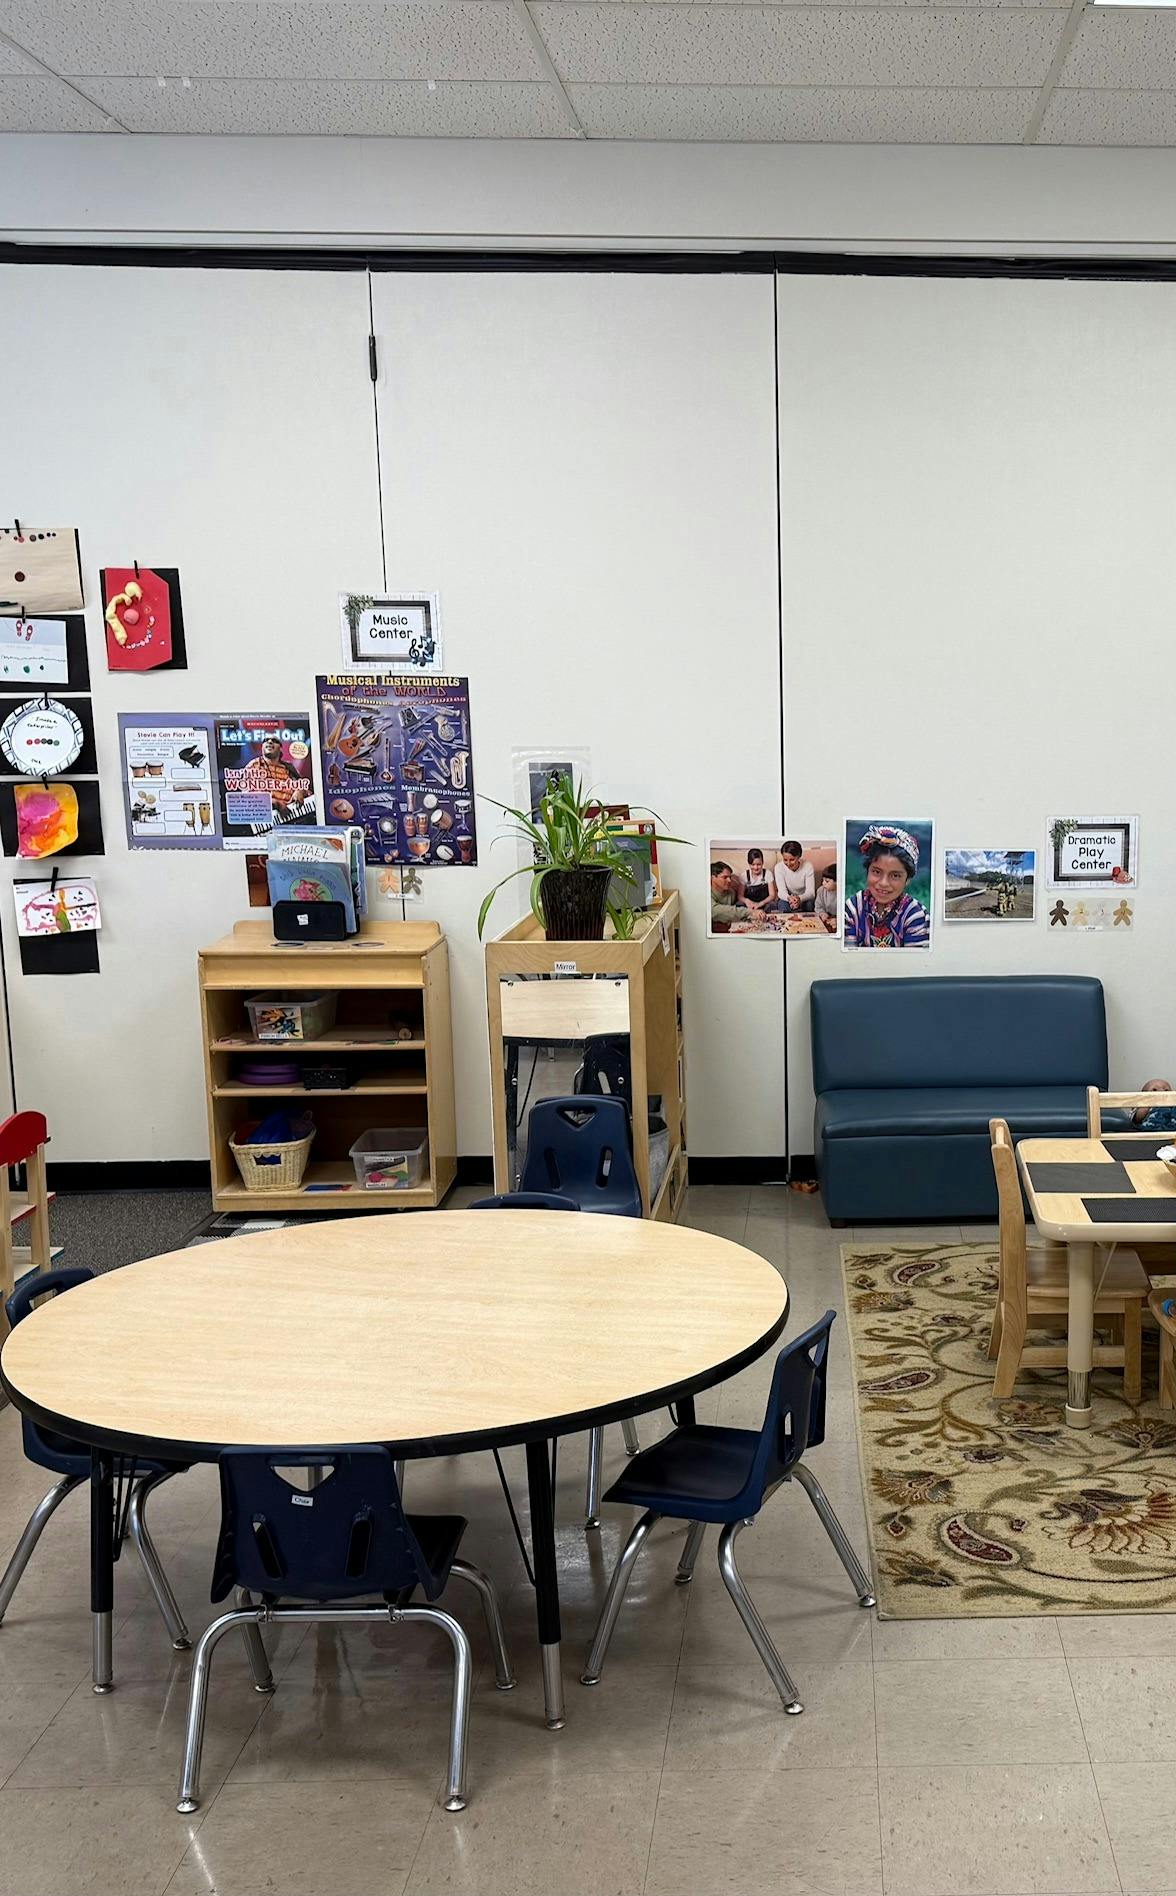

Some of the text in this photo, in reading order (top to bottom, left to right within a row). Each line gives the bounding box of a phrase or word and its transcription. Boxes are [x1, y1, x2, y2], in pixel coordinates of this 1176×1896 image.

[373, 614, 408, 626] Music
[369, 627, 413, 639] Center
[326, 675, 460, 687] Musical Instruments
[342, 686, 356, 696] of
[362, 686, 388, 697] the
[222, 728, 252, 741] Let's
[281, 728, 304, 741] Out
[224, 768, 267, 778] Isn't He
[1068, 835, 1116, 845] Dramatic
[281, 844, 329, 860] MICHAEL
[1079, 847, 1104, 859] Play
[1071, 859, 1112, 870] Center
